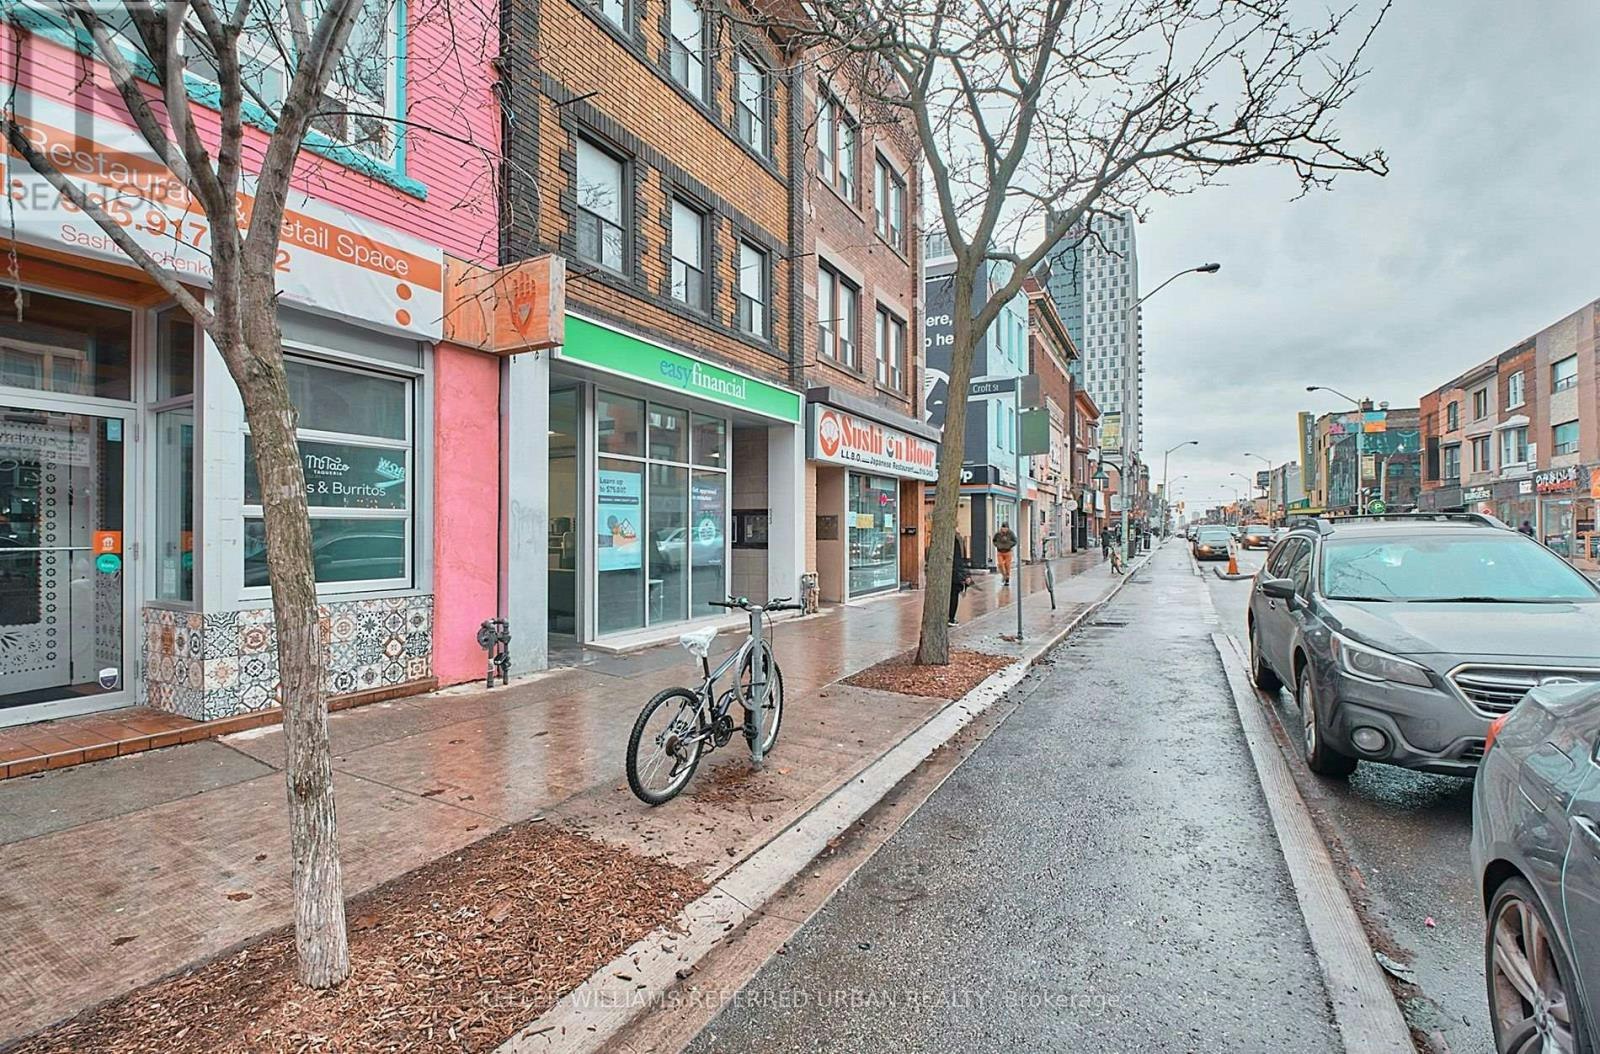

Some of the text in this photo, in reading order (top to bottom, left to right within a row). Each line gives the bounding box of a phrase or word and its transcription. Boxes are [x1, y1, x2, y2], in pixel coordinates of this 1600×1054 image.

[280, 219, 329, 250] etail
[336, 234, 409, 277] Space
[660, 360, 746, 400] easyfinancial
[972, 383, 999, 393] Croft St
[841, 414, 882, 455] Sushi
[905, 436, 935, 468] Bloor
[317, 481, 329, 494] &
[332, 482, 386, 497] Burritos
